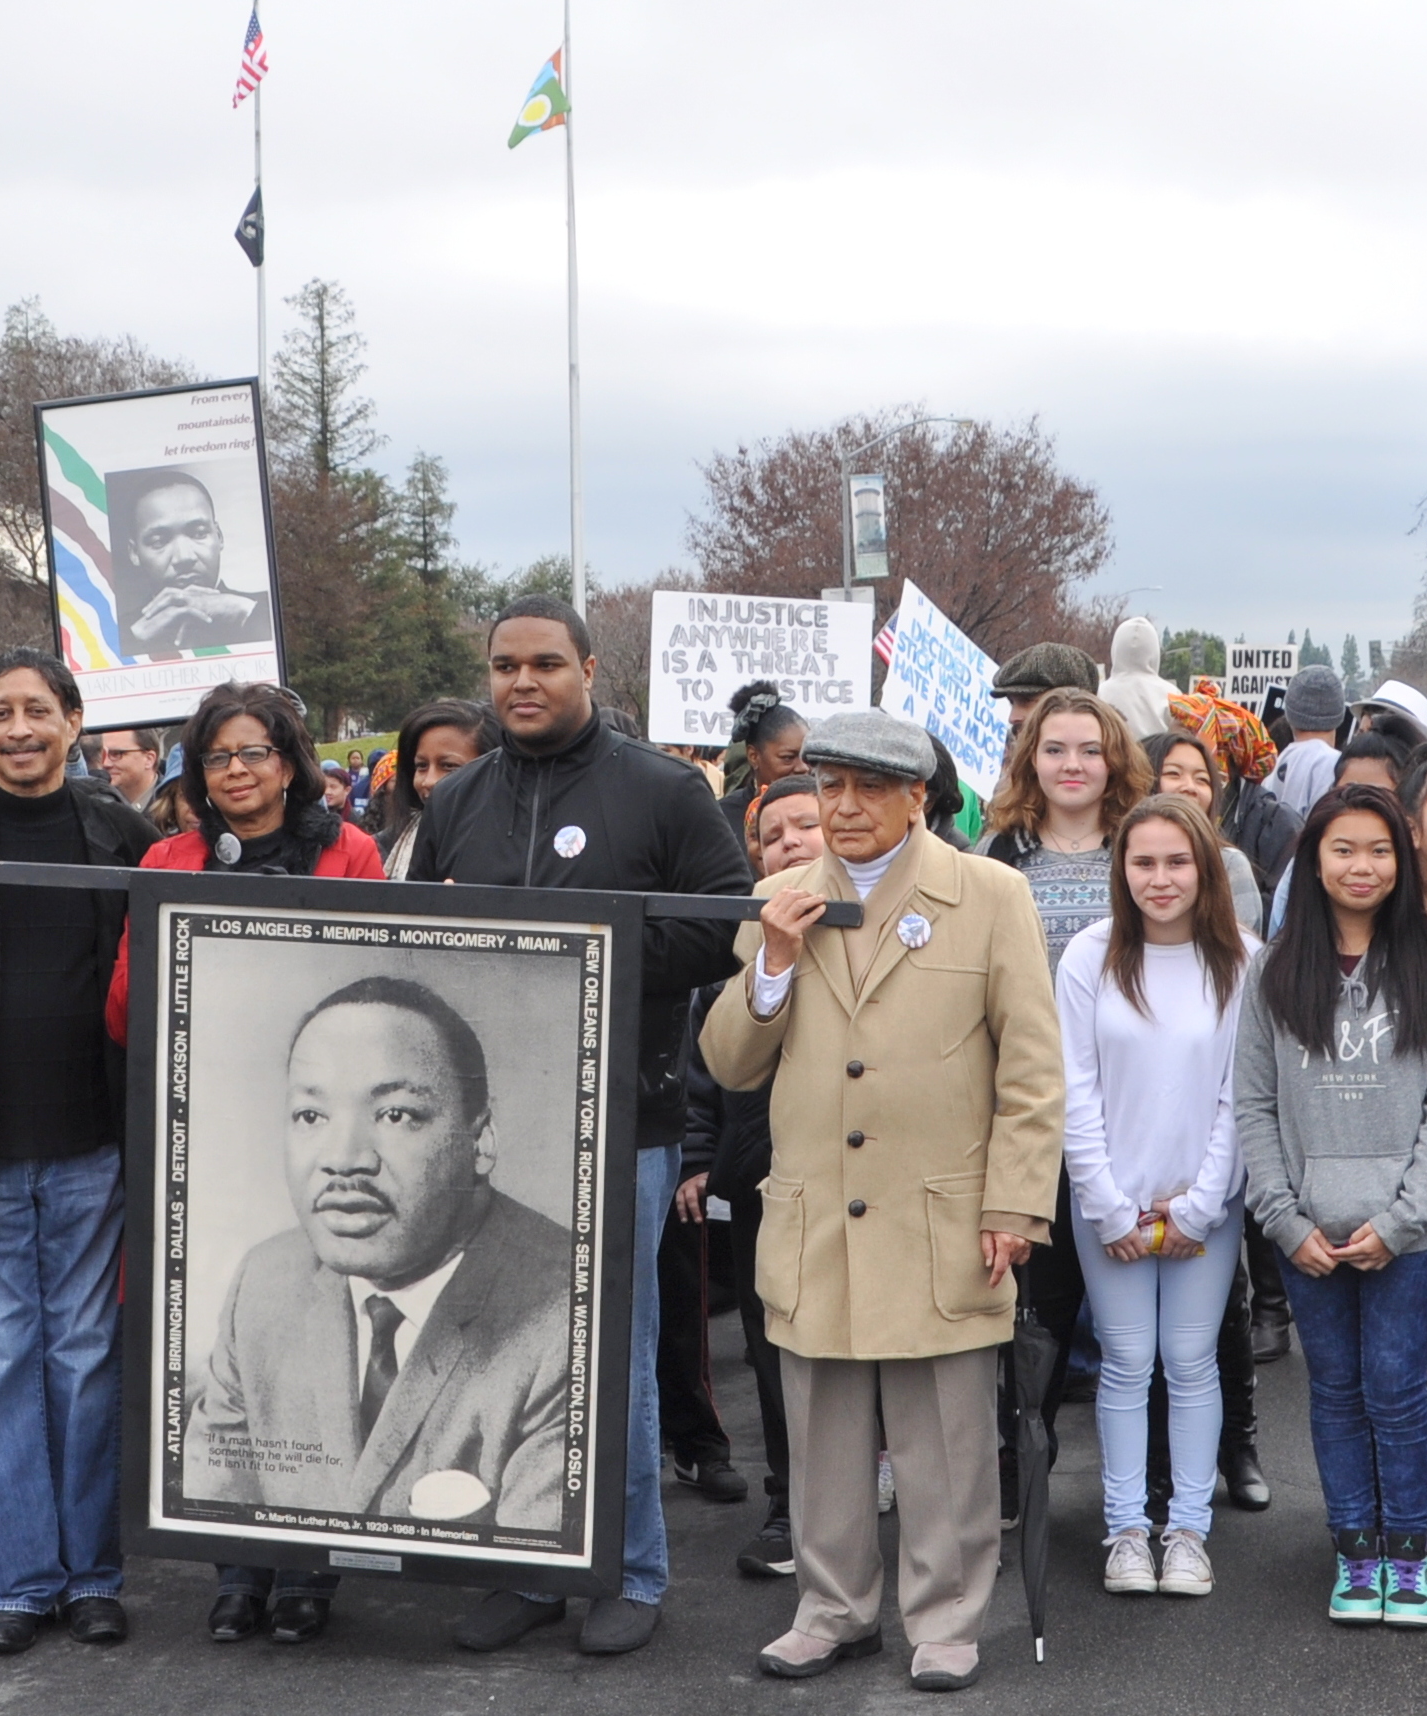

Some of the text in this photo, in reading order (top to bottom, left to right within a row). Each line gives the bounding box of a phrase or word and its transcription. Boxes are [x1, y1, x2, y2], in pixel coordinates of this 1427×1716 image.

[190, 391, 250, 405] From every
[164, 437, 256, 456] let freedom ring!
[688, 598, 829, 628] INJUSTICE
[668, 624, 829, 654] ANYWHERE
[943, 623, 987, 676] HAVE
[662, 649, 840, 677] IS A THREAT
[1232, 649, 1292, 669] UNITED
[142, 666, 201, 689] LUTHER
[209, 660, 246, 682] KING
[676, 678, 714, 702] TO
[893, 653, 930, 701] HATE
[952, 706, 963, 730] 2
[979, 680, 997, 709] TO
[902, 694, 915, 718] A
[974, 700, 1007, 742] LOVE
[211, 919, 561, 952] LOS ANGELES MEMPHIS MONTGOMERY MIAMI
[585, 938, 600, 974] NEW
[582, 976, 599, 1050] ORLEANS
[581, 1058, 596, 1094] NEW
[1322, 1074, 1344, 1082] NEW
[579, 1096, 595, 1141] YORK
[167, 917, 191, 1454] ATLANTA BIRMINGHAM DALLAS DETROIT JACKSON LITTLE ROCK
[576, 1150, 593, 1234] RICHMOND
[574, 1243, 590, 1295] SELMA
[208, 1446, 343, 1468] something he will die for,
[219, 1435, 226, 1444] a
[229, 1436, 253, 1447] man
[255, 1437, 288, 1449] hasn't
[291, 1440, 323, 1452] found
[208, 1457, 222, 1468] he
[224, 1458, 247, 1470] isn't
[249, 1459, 261, 1470] fit
[265, 1461, 276, 1472] to
[567, 1447, 583, 1492] OSLO
[254, 1511, 268, 1521] Dr.
[268, 1512, 297, 1524] Martin
[298, 1514, 327, 1527] Luther
[352, 1519, 363, 1530] Jr.
[420, 1526, 430, 1536] In
[431, 1527, 480, 1541] Memoriam
